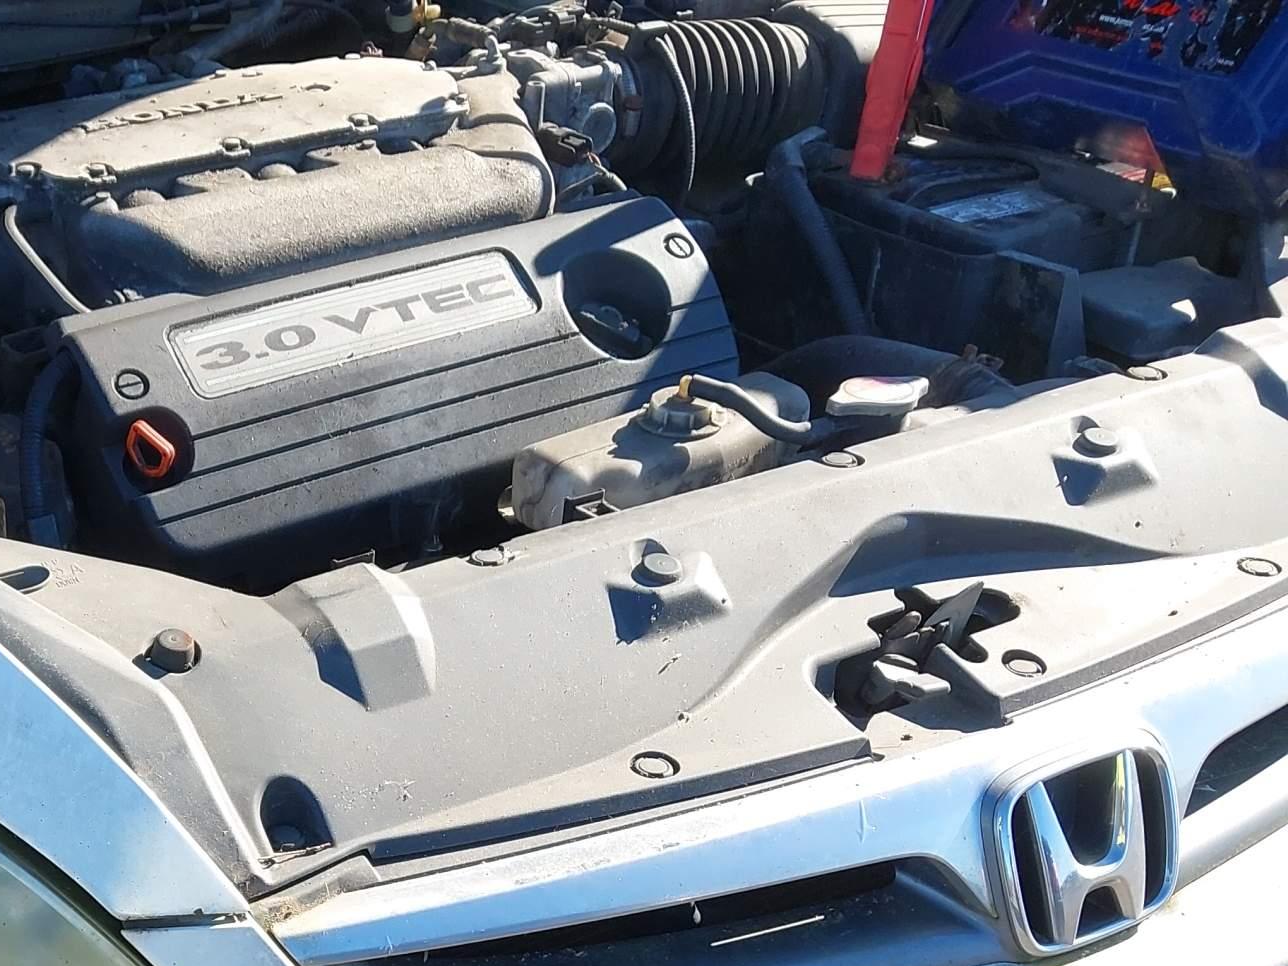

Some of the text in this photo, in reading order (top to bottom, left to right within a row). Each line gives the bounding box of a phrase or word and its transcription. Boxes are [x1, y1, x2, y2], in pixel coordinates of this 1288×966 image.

[81, 93, 284, 134] HONDA
[195, 273, 516, 371] 3.0 VTEC
